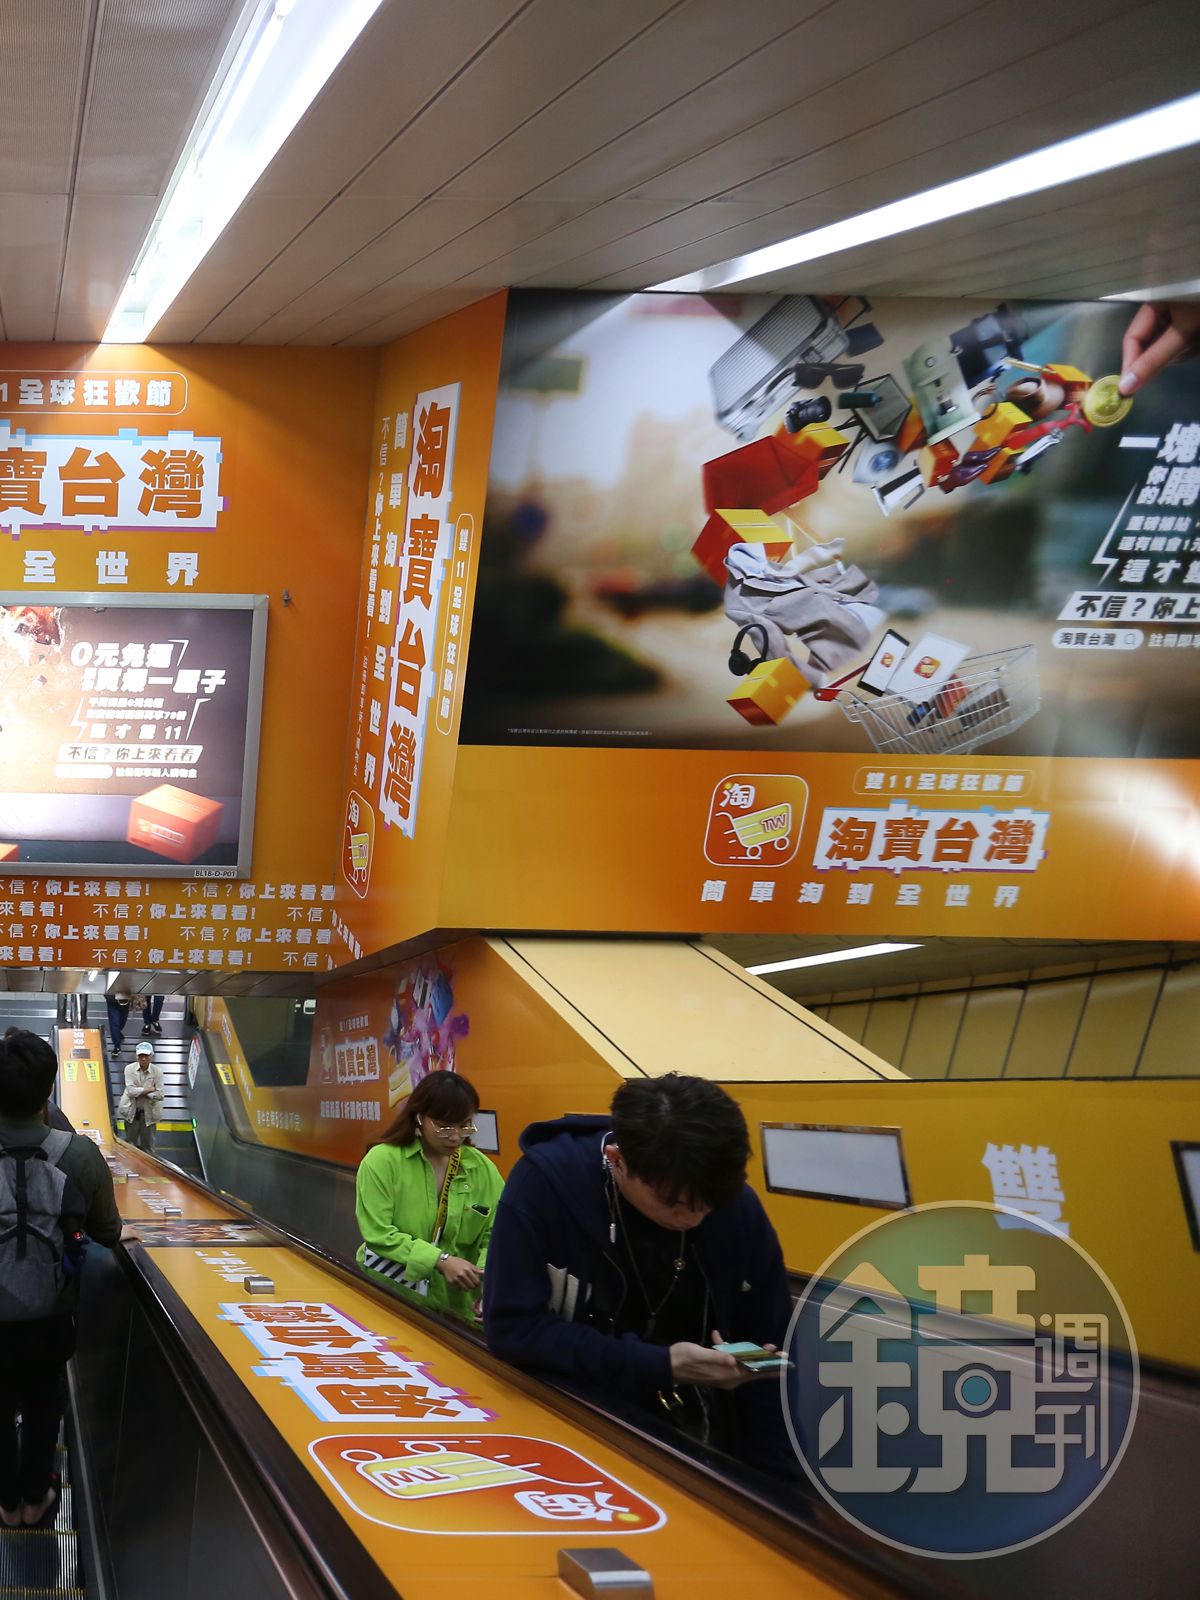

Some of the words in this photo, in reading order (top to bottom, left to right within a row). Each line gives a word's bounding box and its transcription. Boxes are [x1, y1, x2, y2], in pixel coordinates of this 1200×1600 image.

[383, 401, 451, 822] 淘寶台灣
[825, 817, 1035, 865] 淘寶台灣
[701, 879, 1020, 908] 簡單淘到全世界
[238, 1303, 462, 1419] 淘寶台灣
